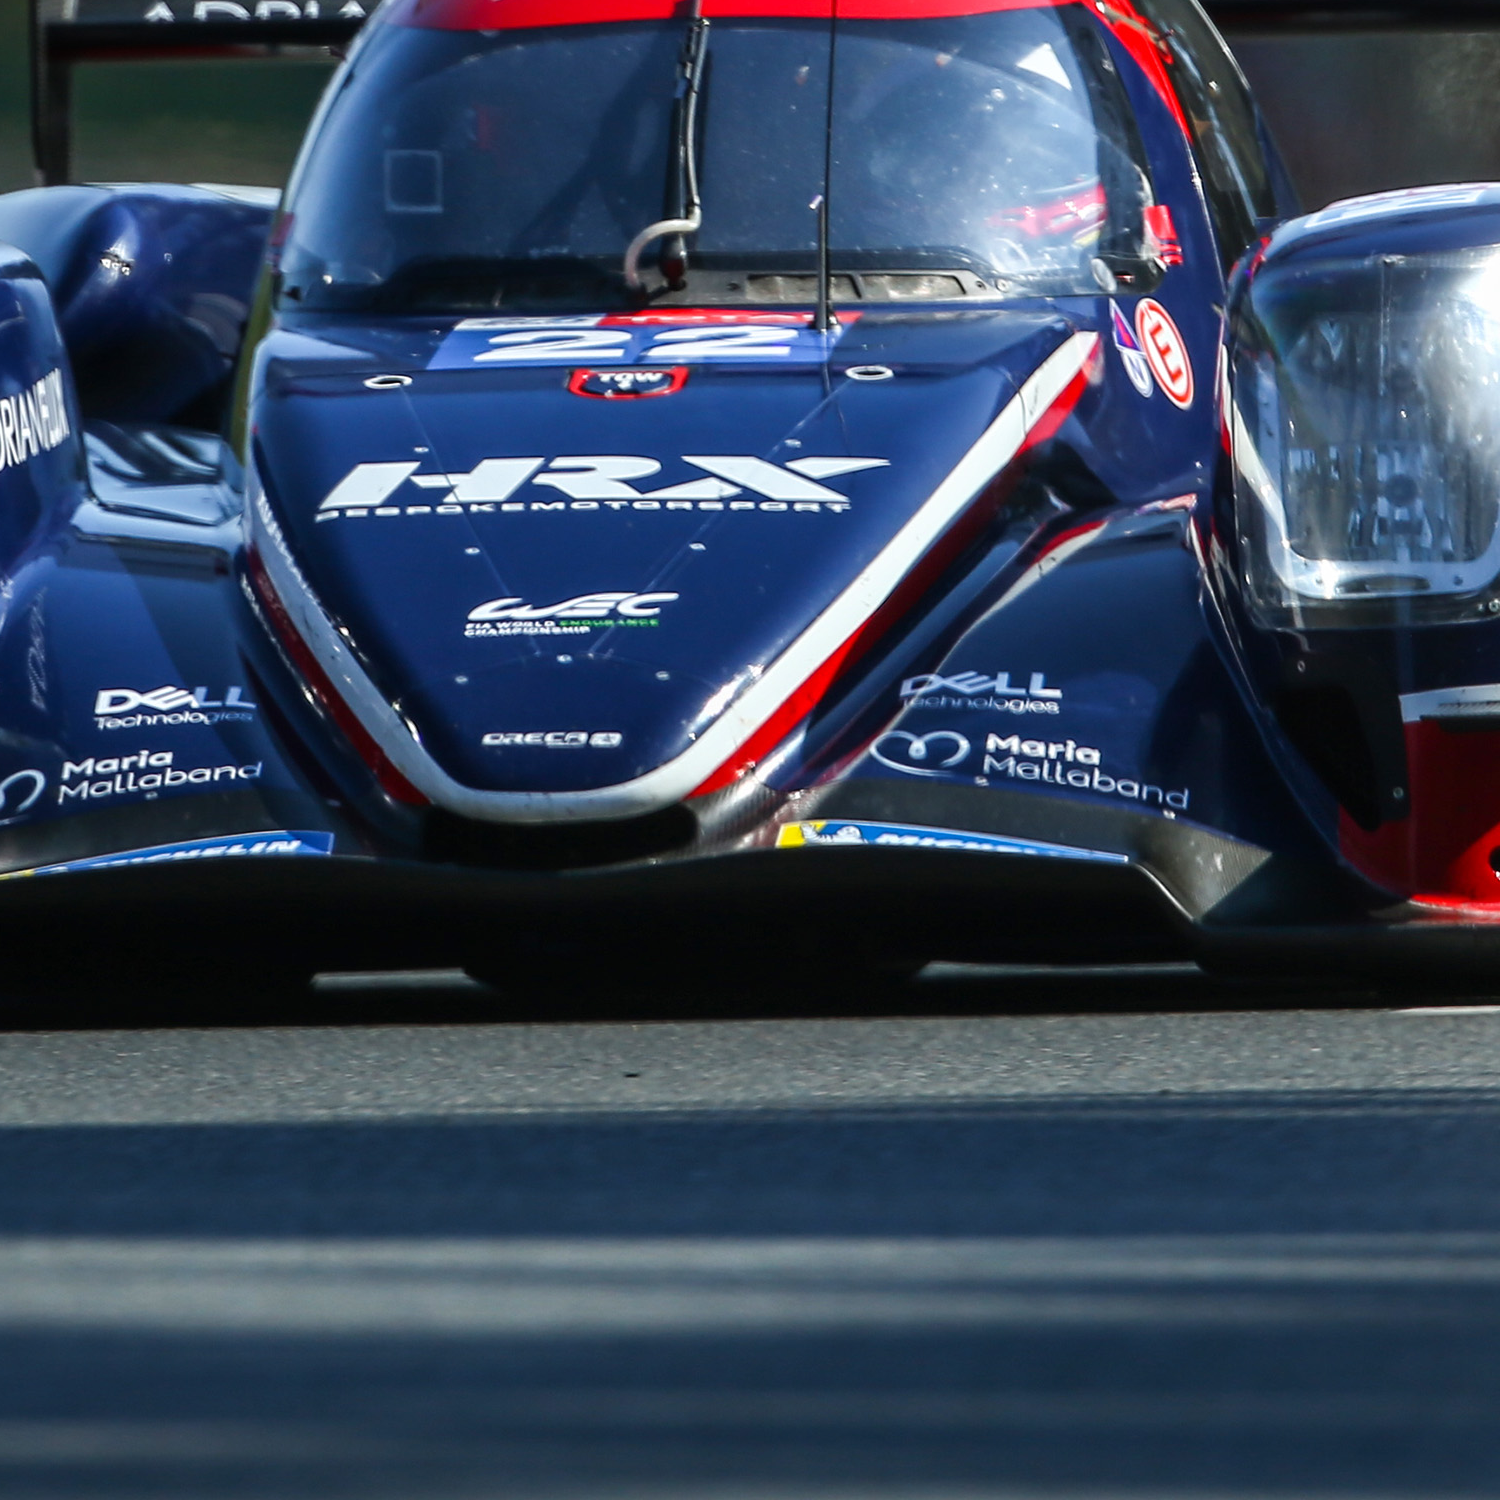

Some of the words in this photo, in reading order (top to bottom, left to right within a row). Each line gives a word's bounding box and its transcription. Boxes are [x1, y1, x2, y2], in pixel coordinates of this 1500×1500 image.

[474, 325, 799, 361] 22
[598, 372, 664, 383] TOW
[319, 455, 891, 509] HRX
[900, 670, 1063, 698] DELL
[95, 686, 257, 715] DELL
[94, 711, 253, 730] Technologies
[482, 731, 589, 747] ORECA
[986, 733, 1101, 766] Maria
[61, 750, 174, 781] Maria
[58, 762, 263, 805] Mallaband
[983, 754, 1189, 809] Mallaband
